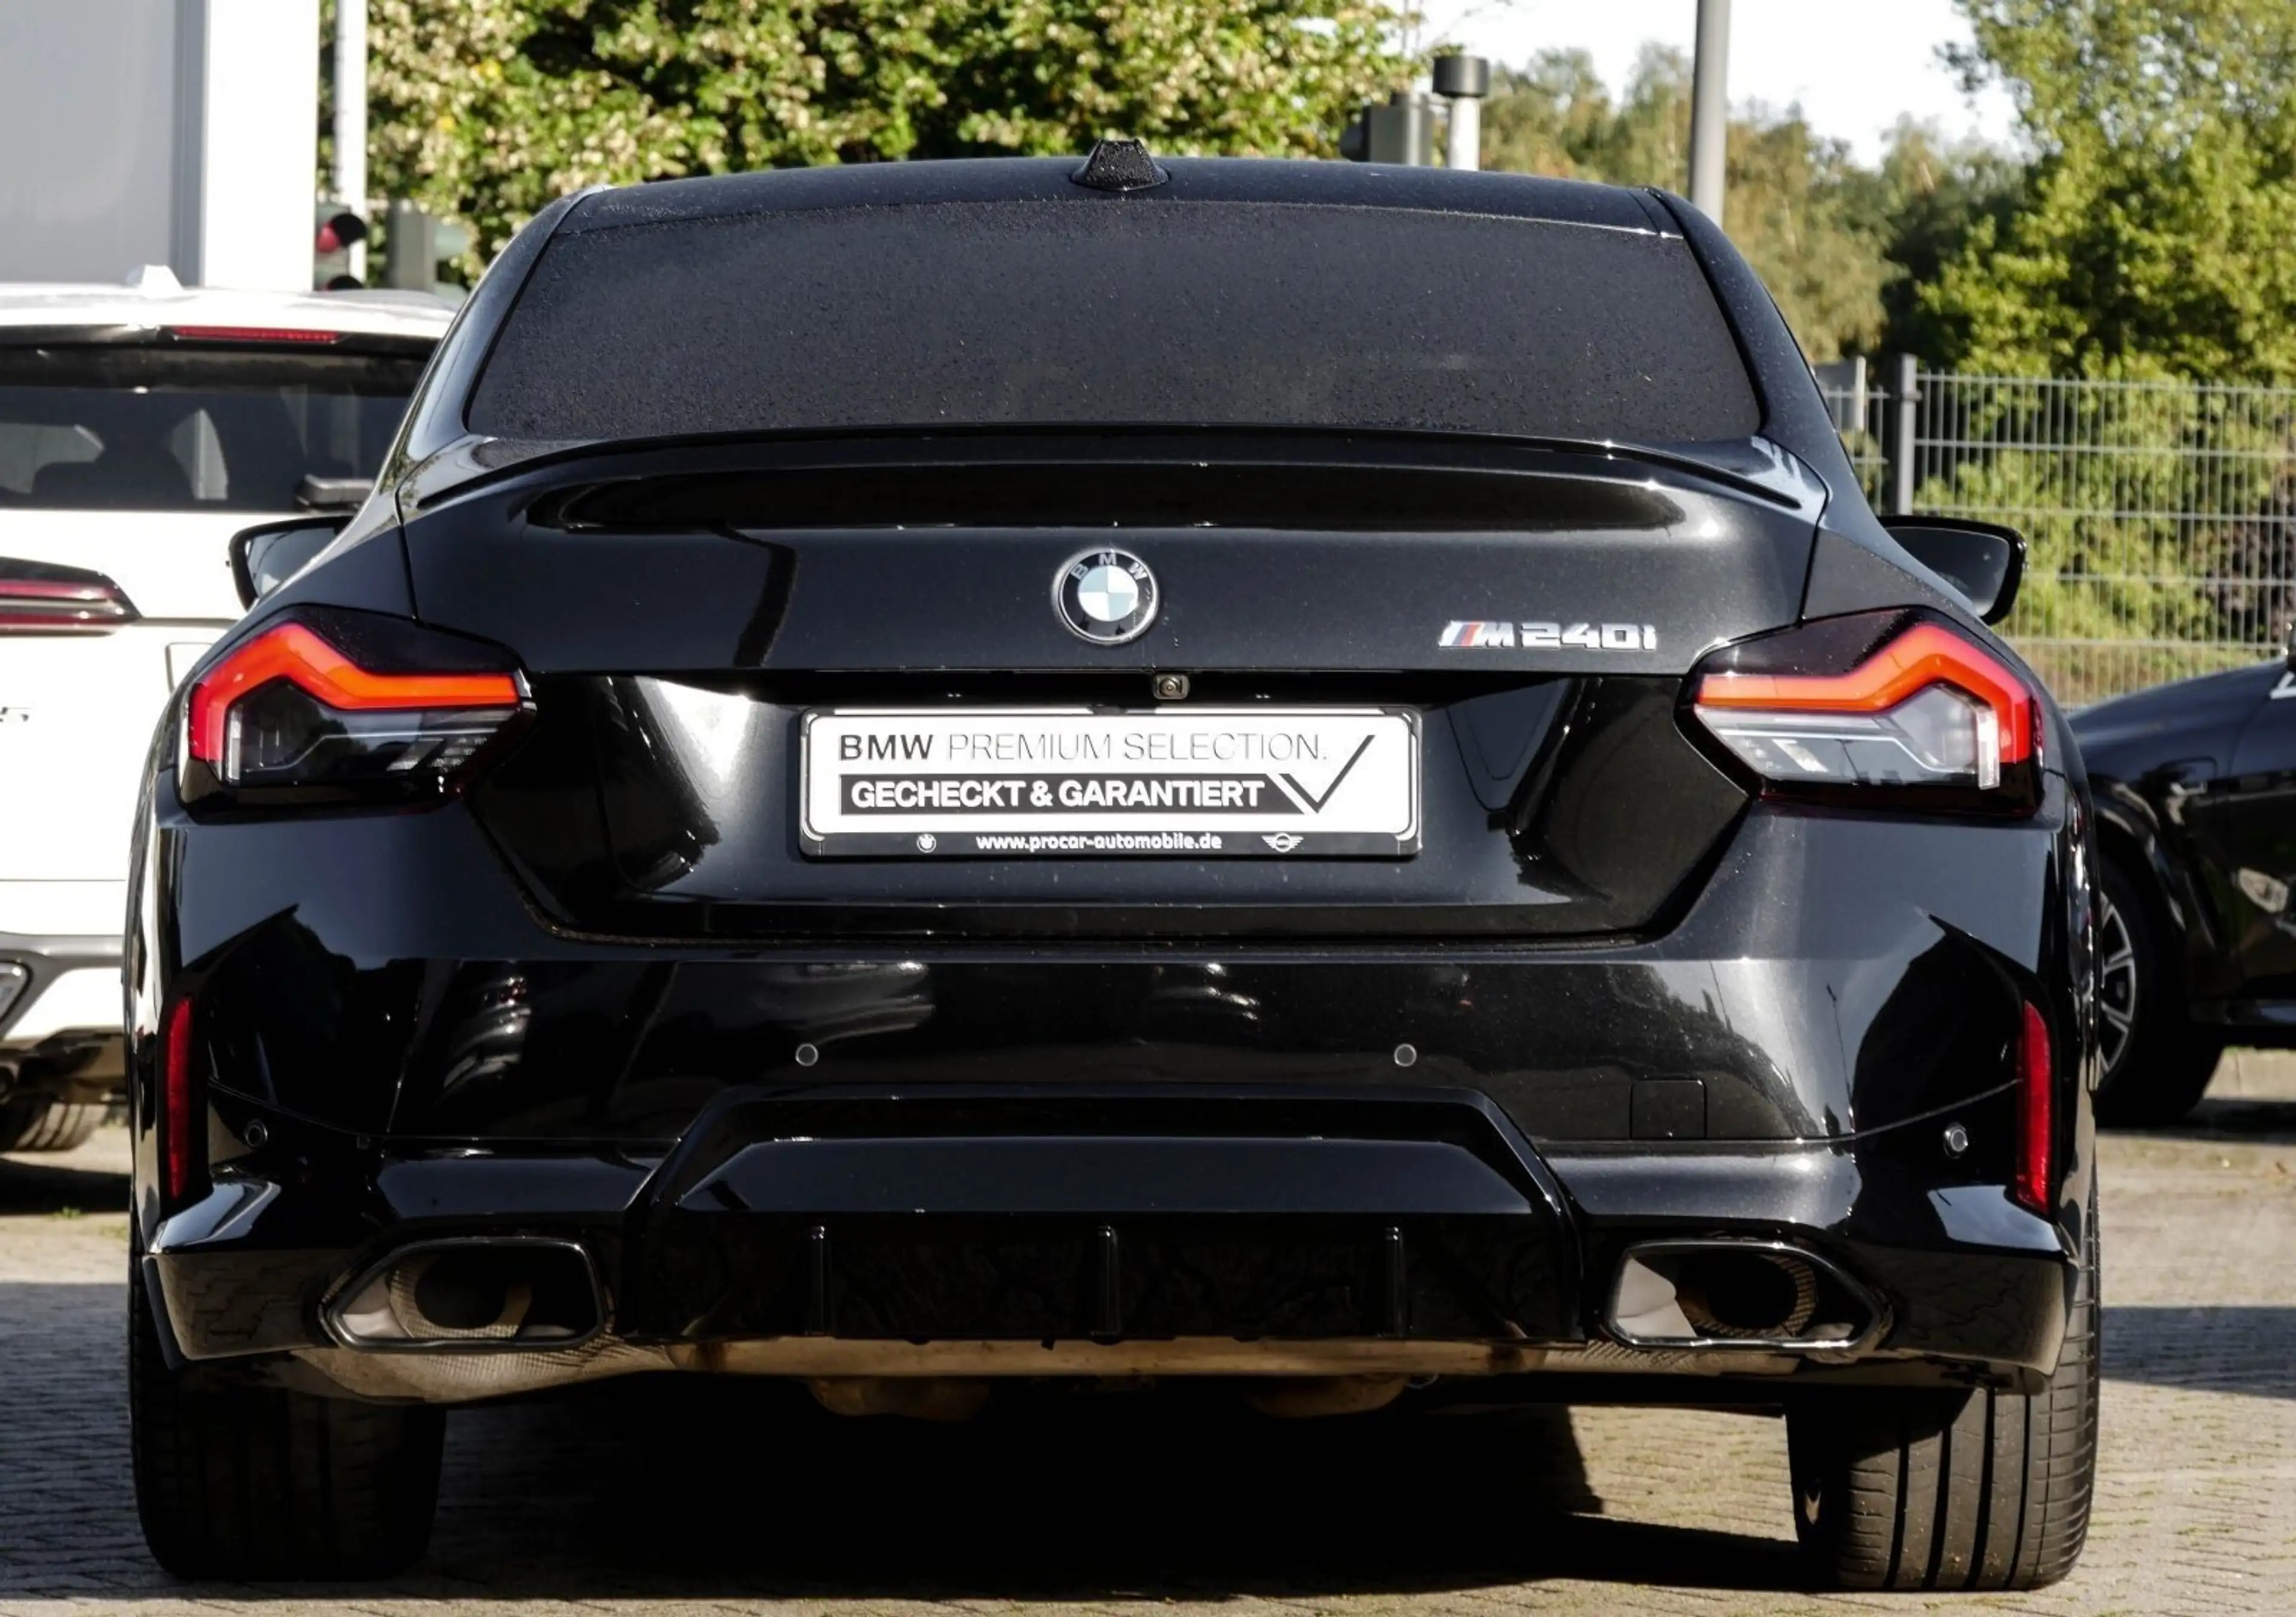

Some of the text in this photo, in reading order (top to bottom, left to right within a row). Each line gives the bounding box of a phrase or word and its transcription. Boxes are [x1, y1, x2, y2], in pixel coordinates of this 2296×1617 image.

[1069, 553, 1148, 581] BMW
[839, 733, 1327, 761] BMW PREMIUM SELECTION.
[851, 780, 1265, 807] GECHECKT & GARANTIERT
[975, 832, 1222, 852] www.procar-automobile.de
